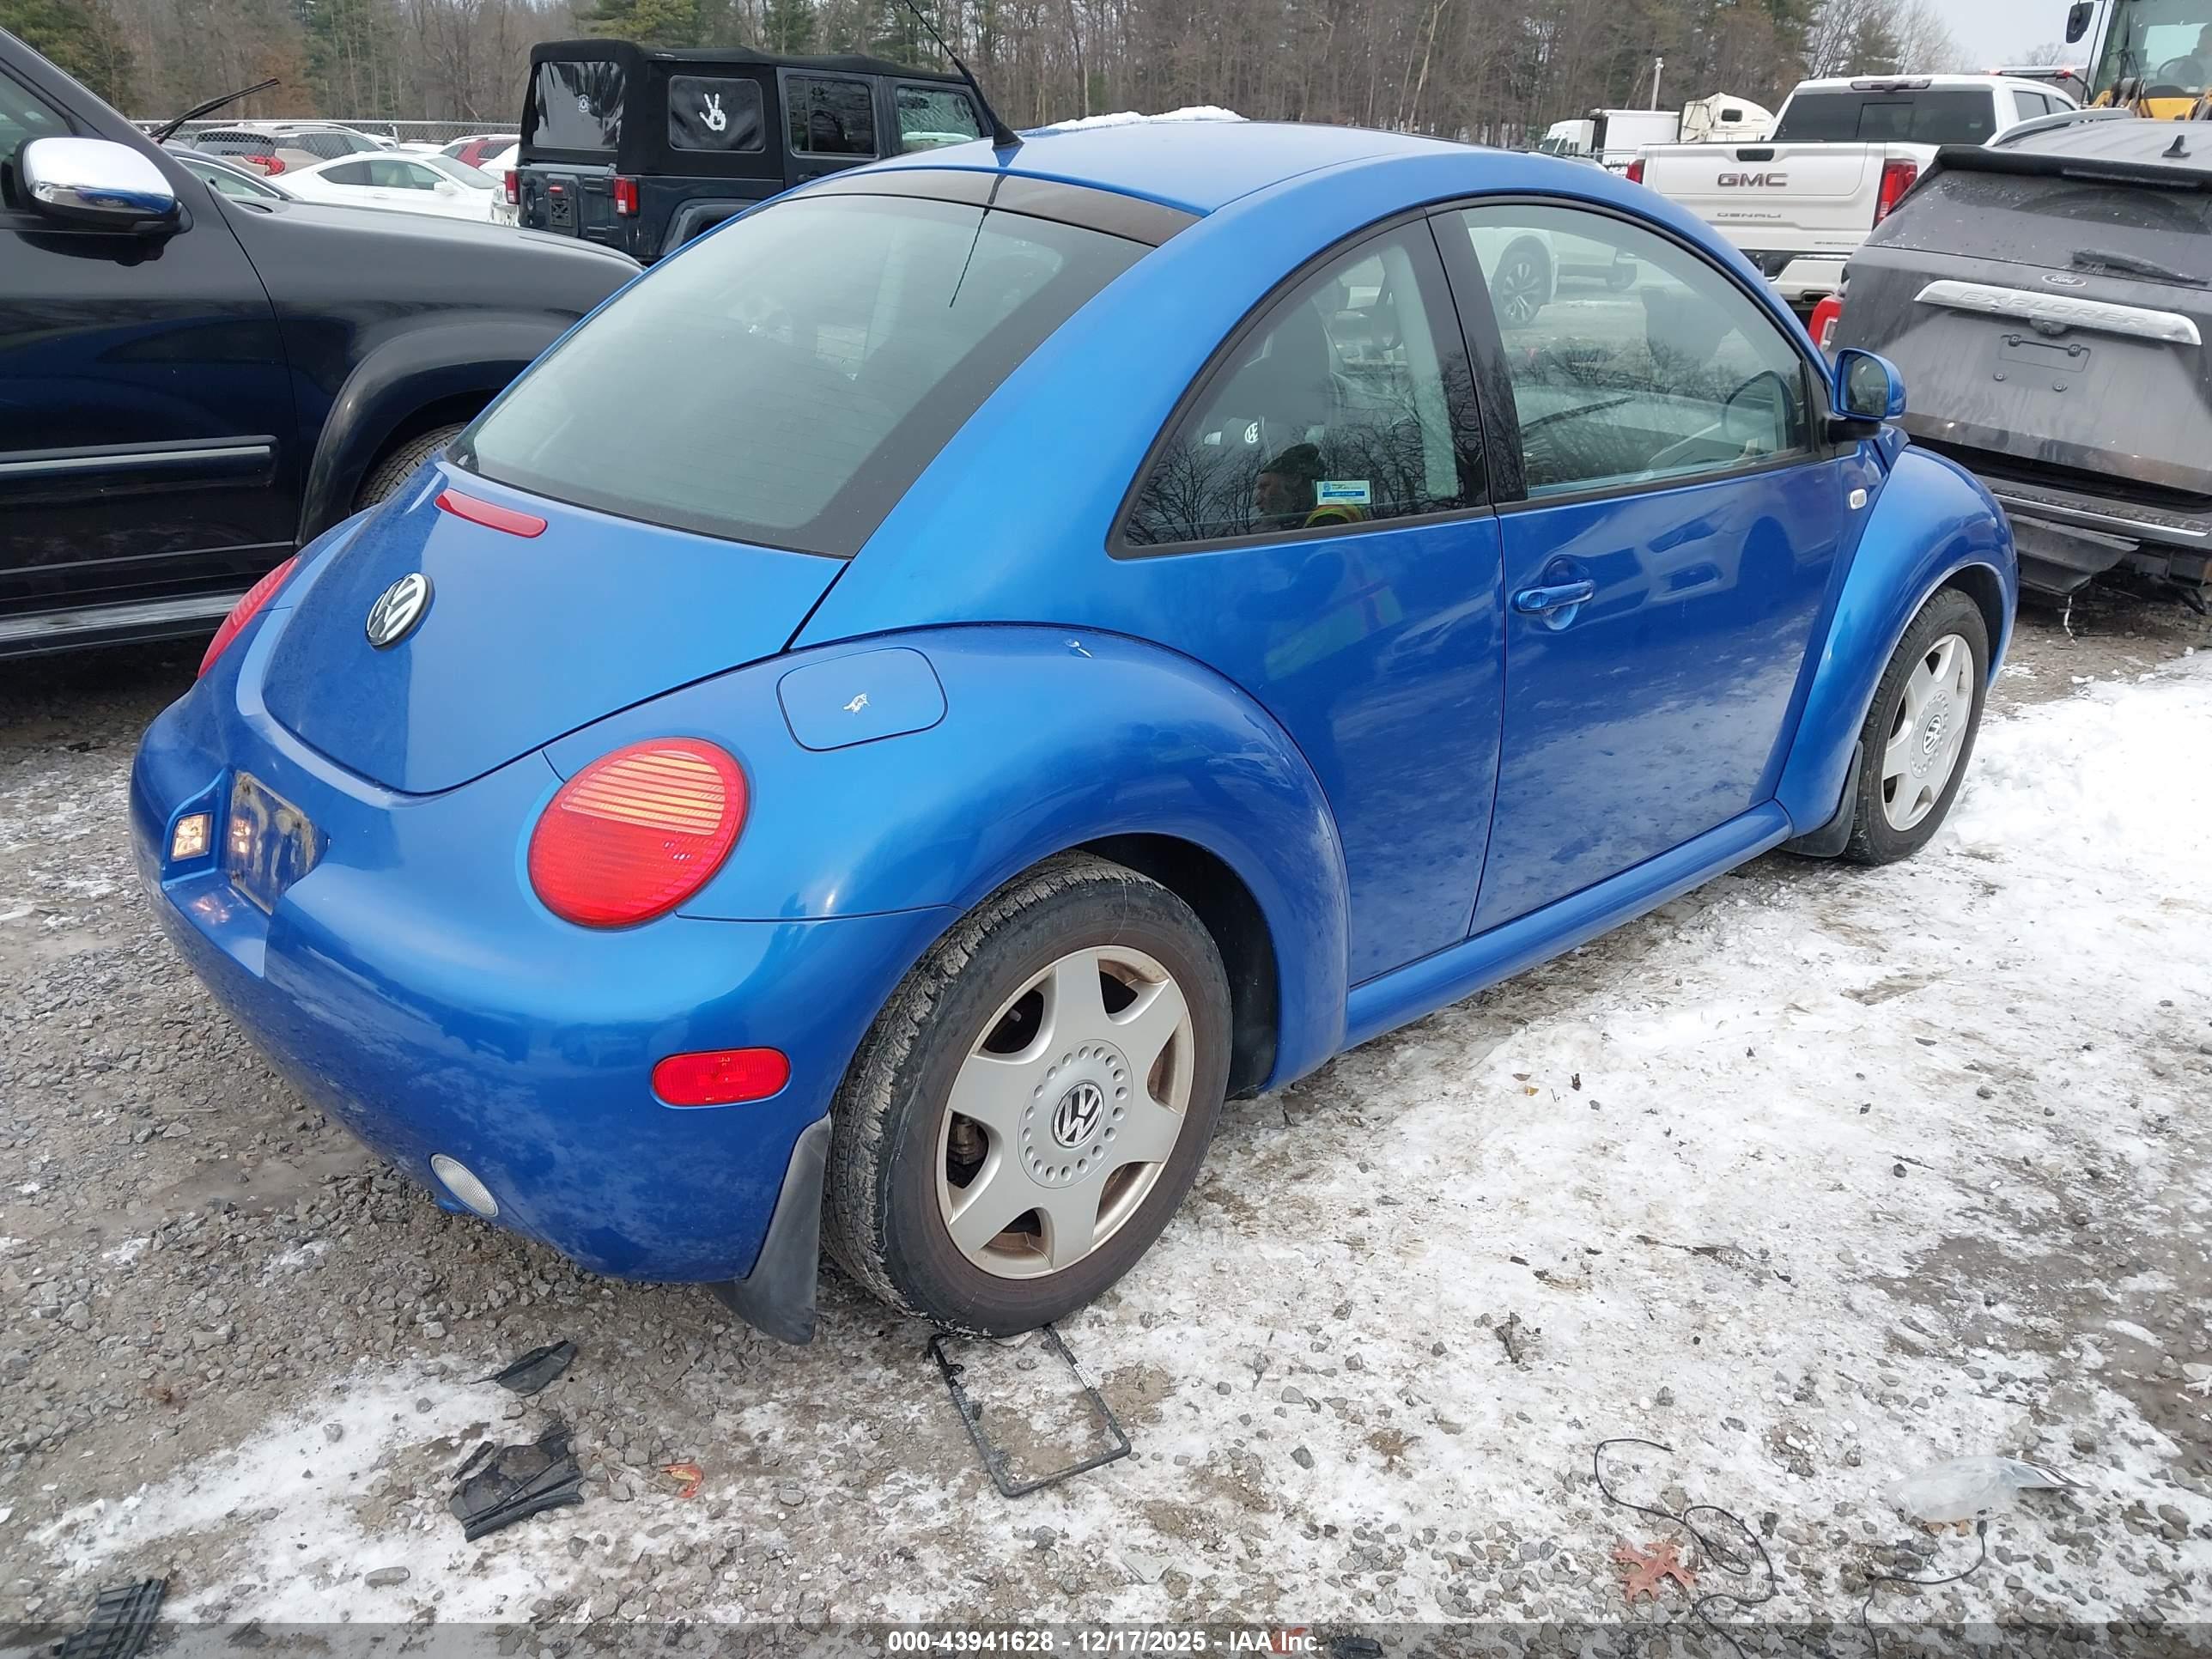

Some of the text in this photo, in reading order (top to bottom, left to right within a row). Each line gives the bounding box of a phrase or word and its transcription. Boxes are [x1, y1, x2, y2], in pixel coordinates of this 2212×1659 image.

[1717, 173, 1788, 188] GMC
[1958, 290, 2148, 327] EXPLORER
[366, 572, 428, 647] VW
[1054, 1082, 1103, 1147] VW
